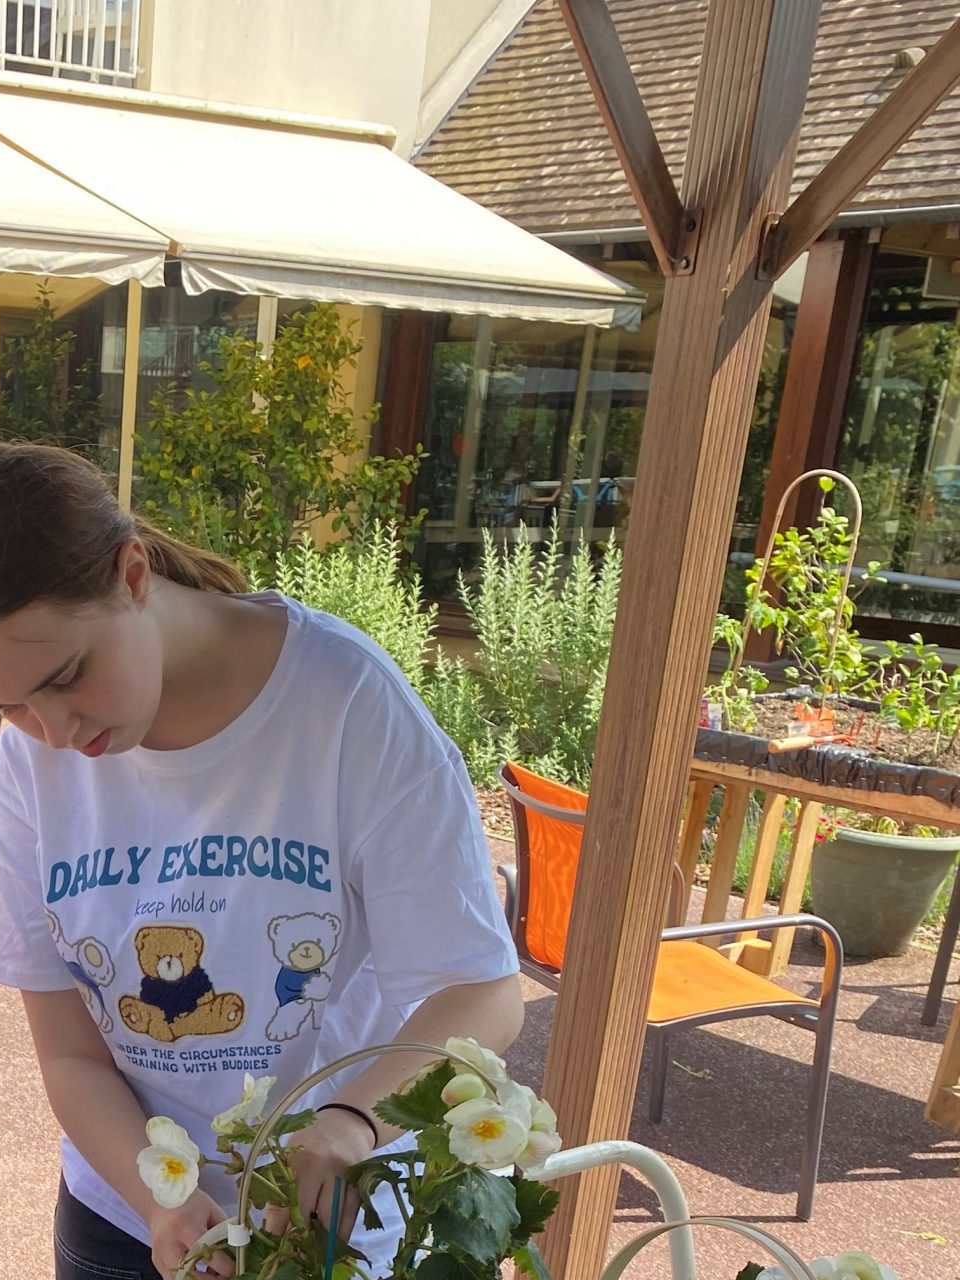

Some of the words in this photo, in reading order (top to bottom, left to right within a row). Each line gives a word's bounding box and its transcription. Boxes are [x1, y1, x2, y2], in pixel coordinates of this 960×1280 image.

[47, 846, 151, 903] DAILY
[157, 835, 332, 893] EXERCISE
[134, 899, 165, 917] keep
[171, 891, 204, 914] hold
[210, 899, 227, 913] on
[152, 1049, 175, 1060] THE
[179, 1044, 282, 1061] CIRCUMSTANCES
[126, 1055, 179, 1073] TRAINING
[183, 1063, 217, 1074] WITH
[222, 1059, 269, 1071] BUDDIES
